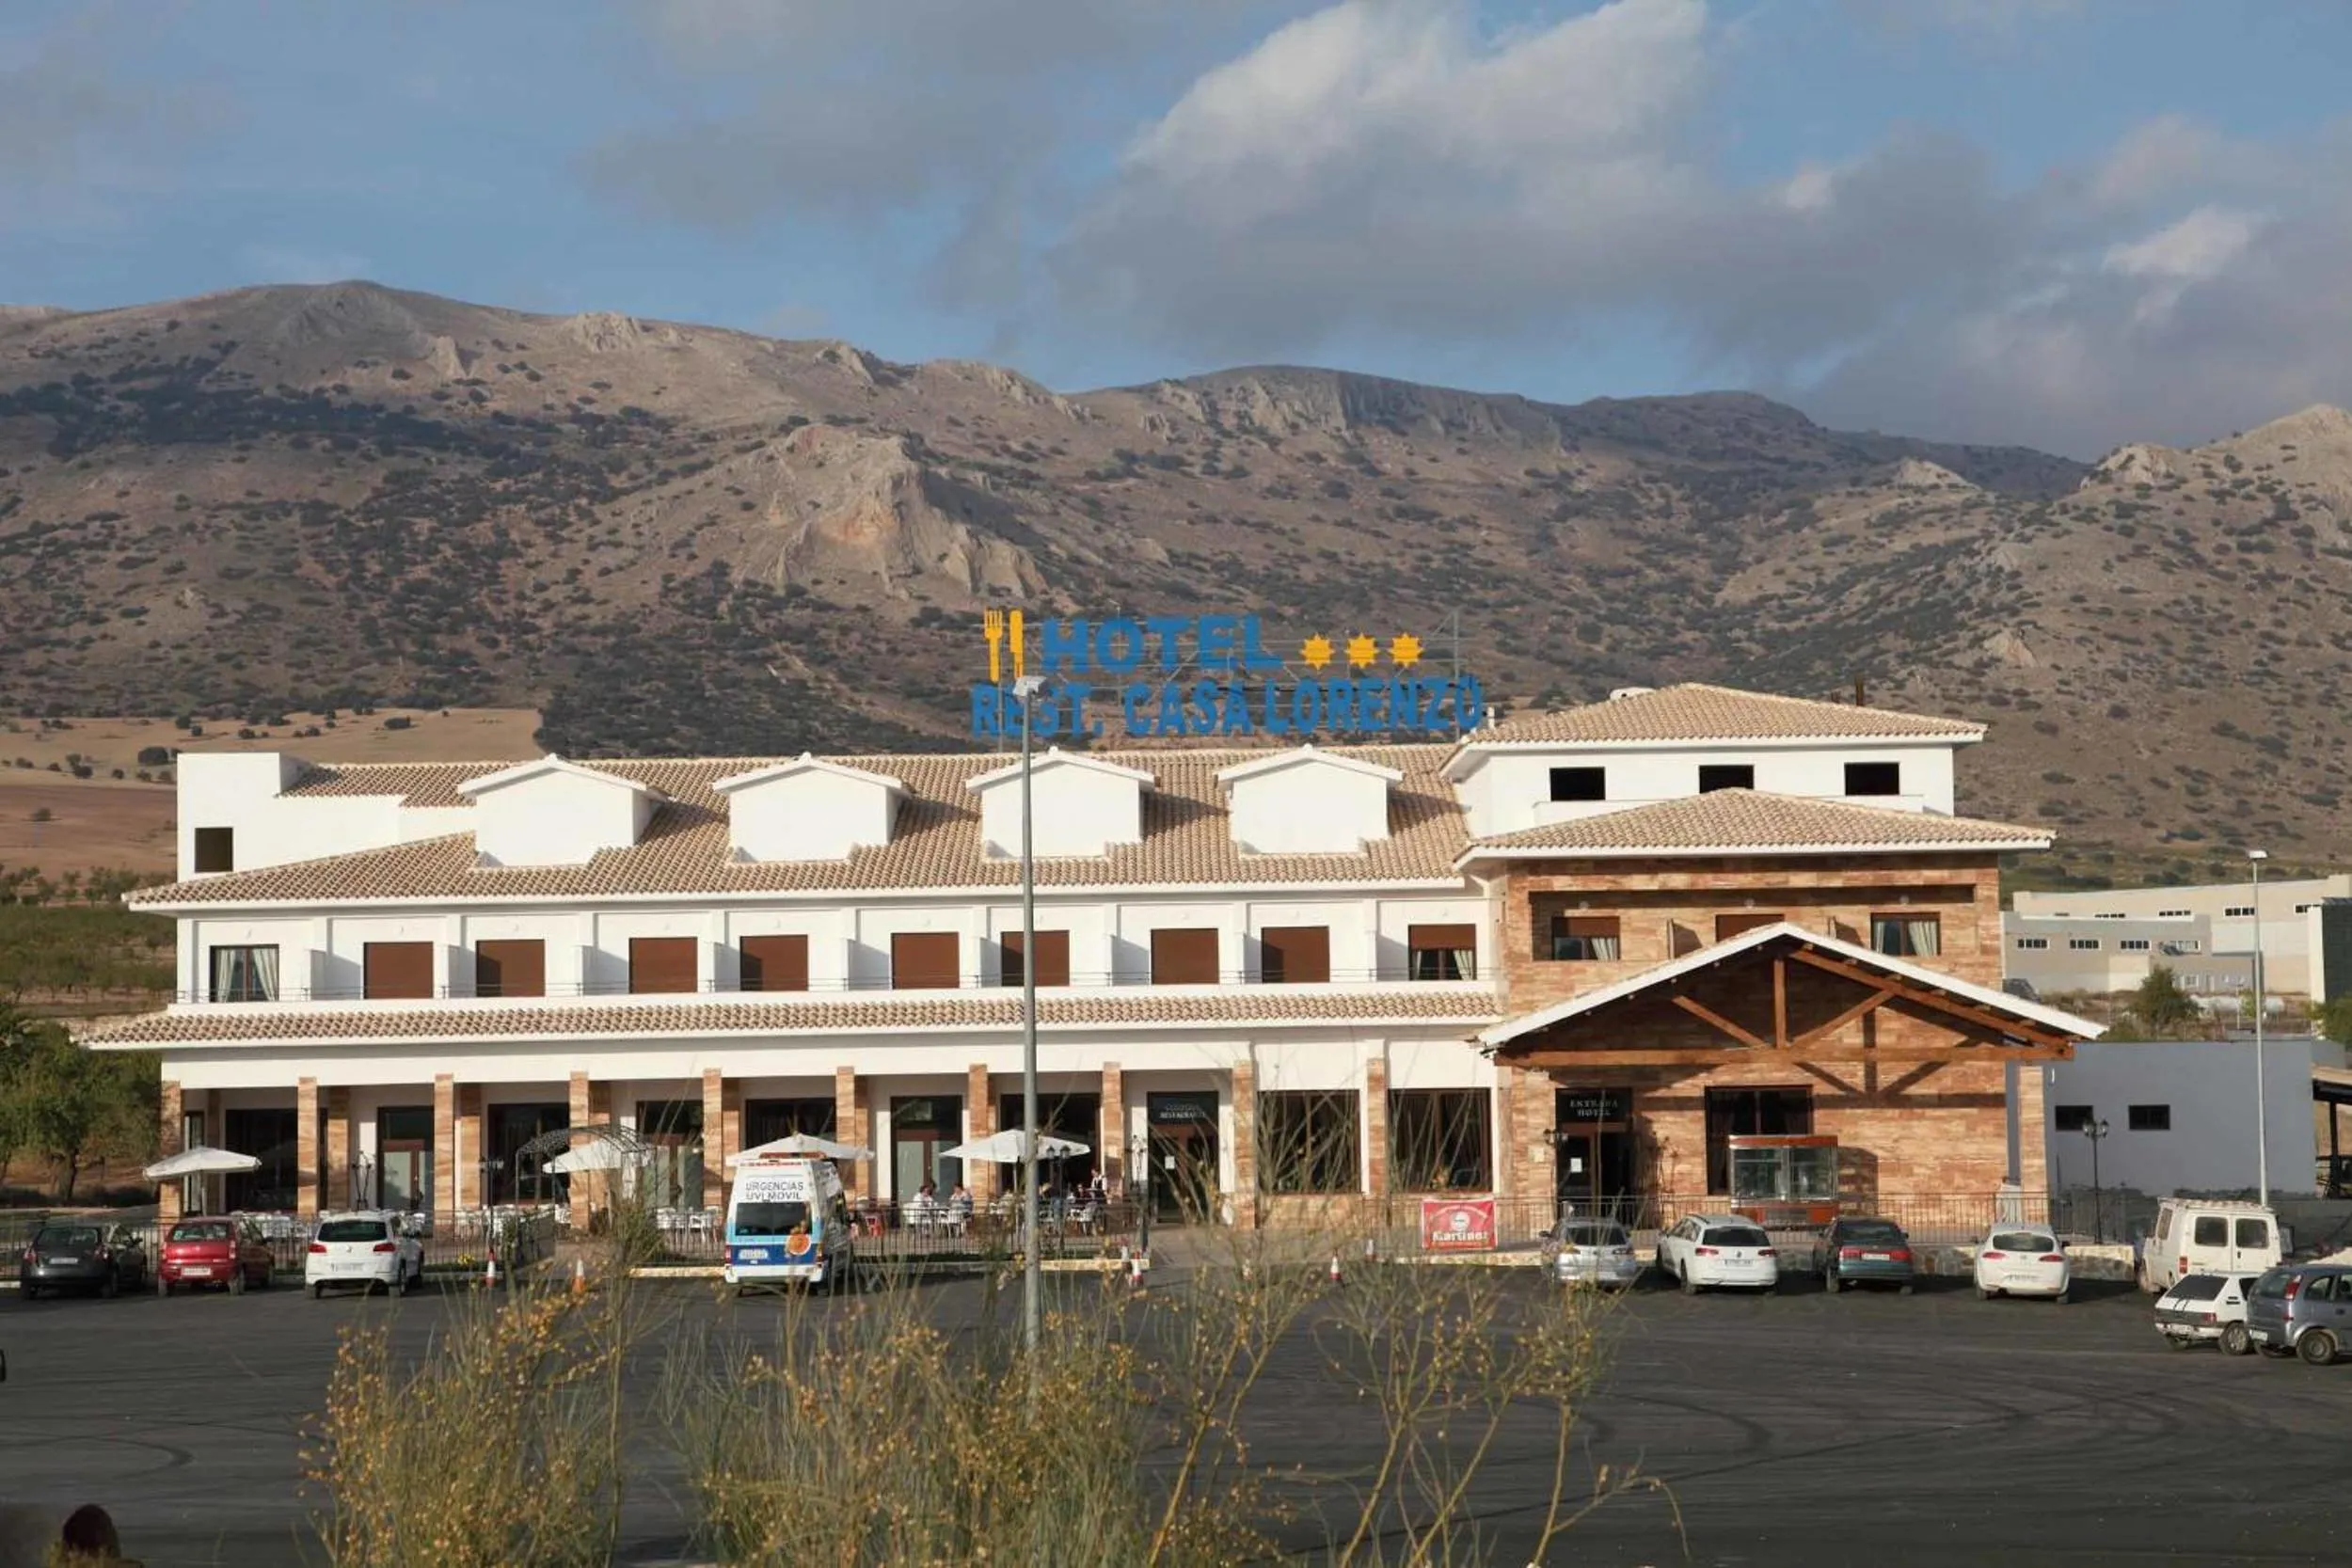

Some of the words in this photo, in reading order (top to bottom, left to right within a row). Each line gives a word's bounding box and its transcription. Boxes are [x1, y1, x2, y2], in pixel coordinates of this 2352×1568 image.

[1041, 614, 1284, 674] HOTEL
[971, 680, 1104, 739] REST.
[1124, 678, 1254, 737] CASA
[1265, 675, 1483, 736] LORENZO
[745, 1181, 804, 1191] URGENCIAS
